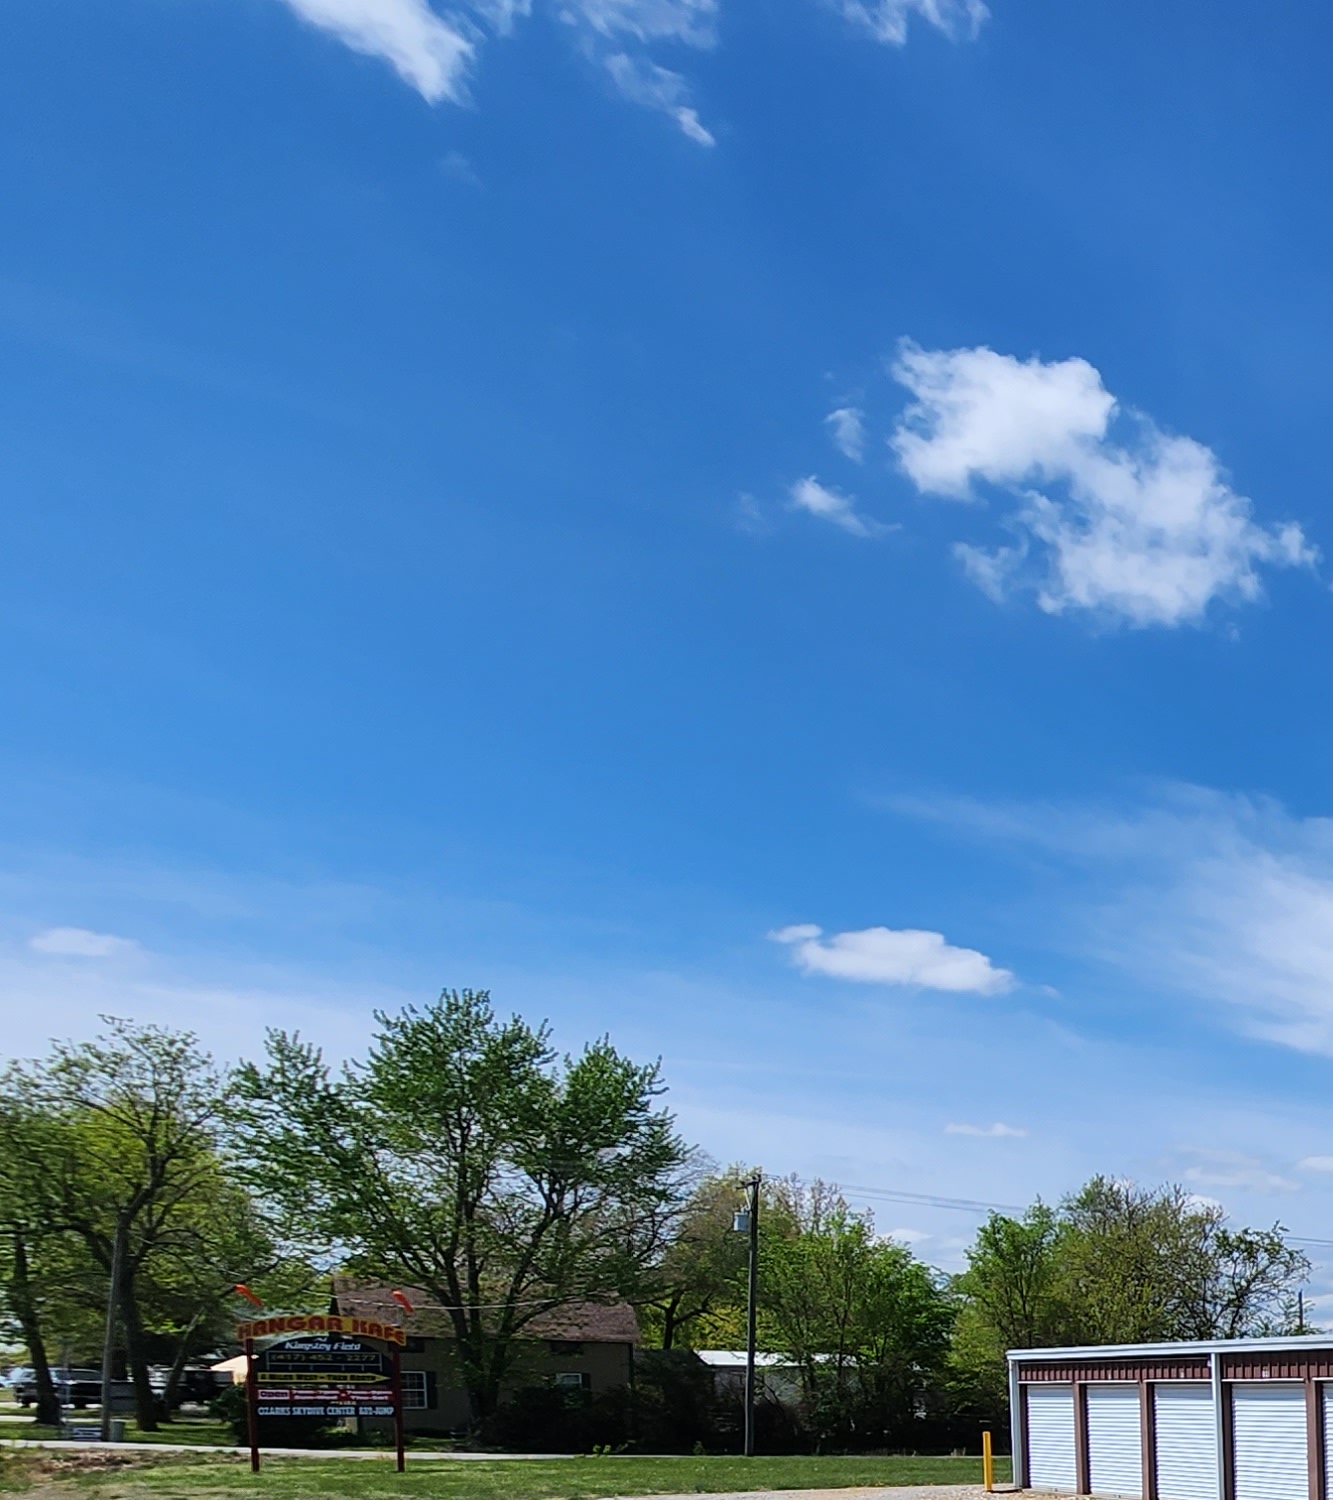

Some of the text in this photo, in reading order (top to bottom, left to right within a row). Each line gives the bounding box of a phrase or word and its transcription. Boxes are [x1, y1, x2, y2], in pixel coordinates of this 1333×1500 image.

[238, 1316, 405, 1345] HANGAR KAFE
[271, 1353, 306, 1361] (417)
